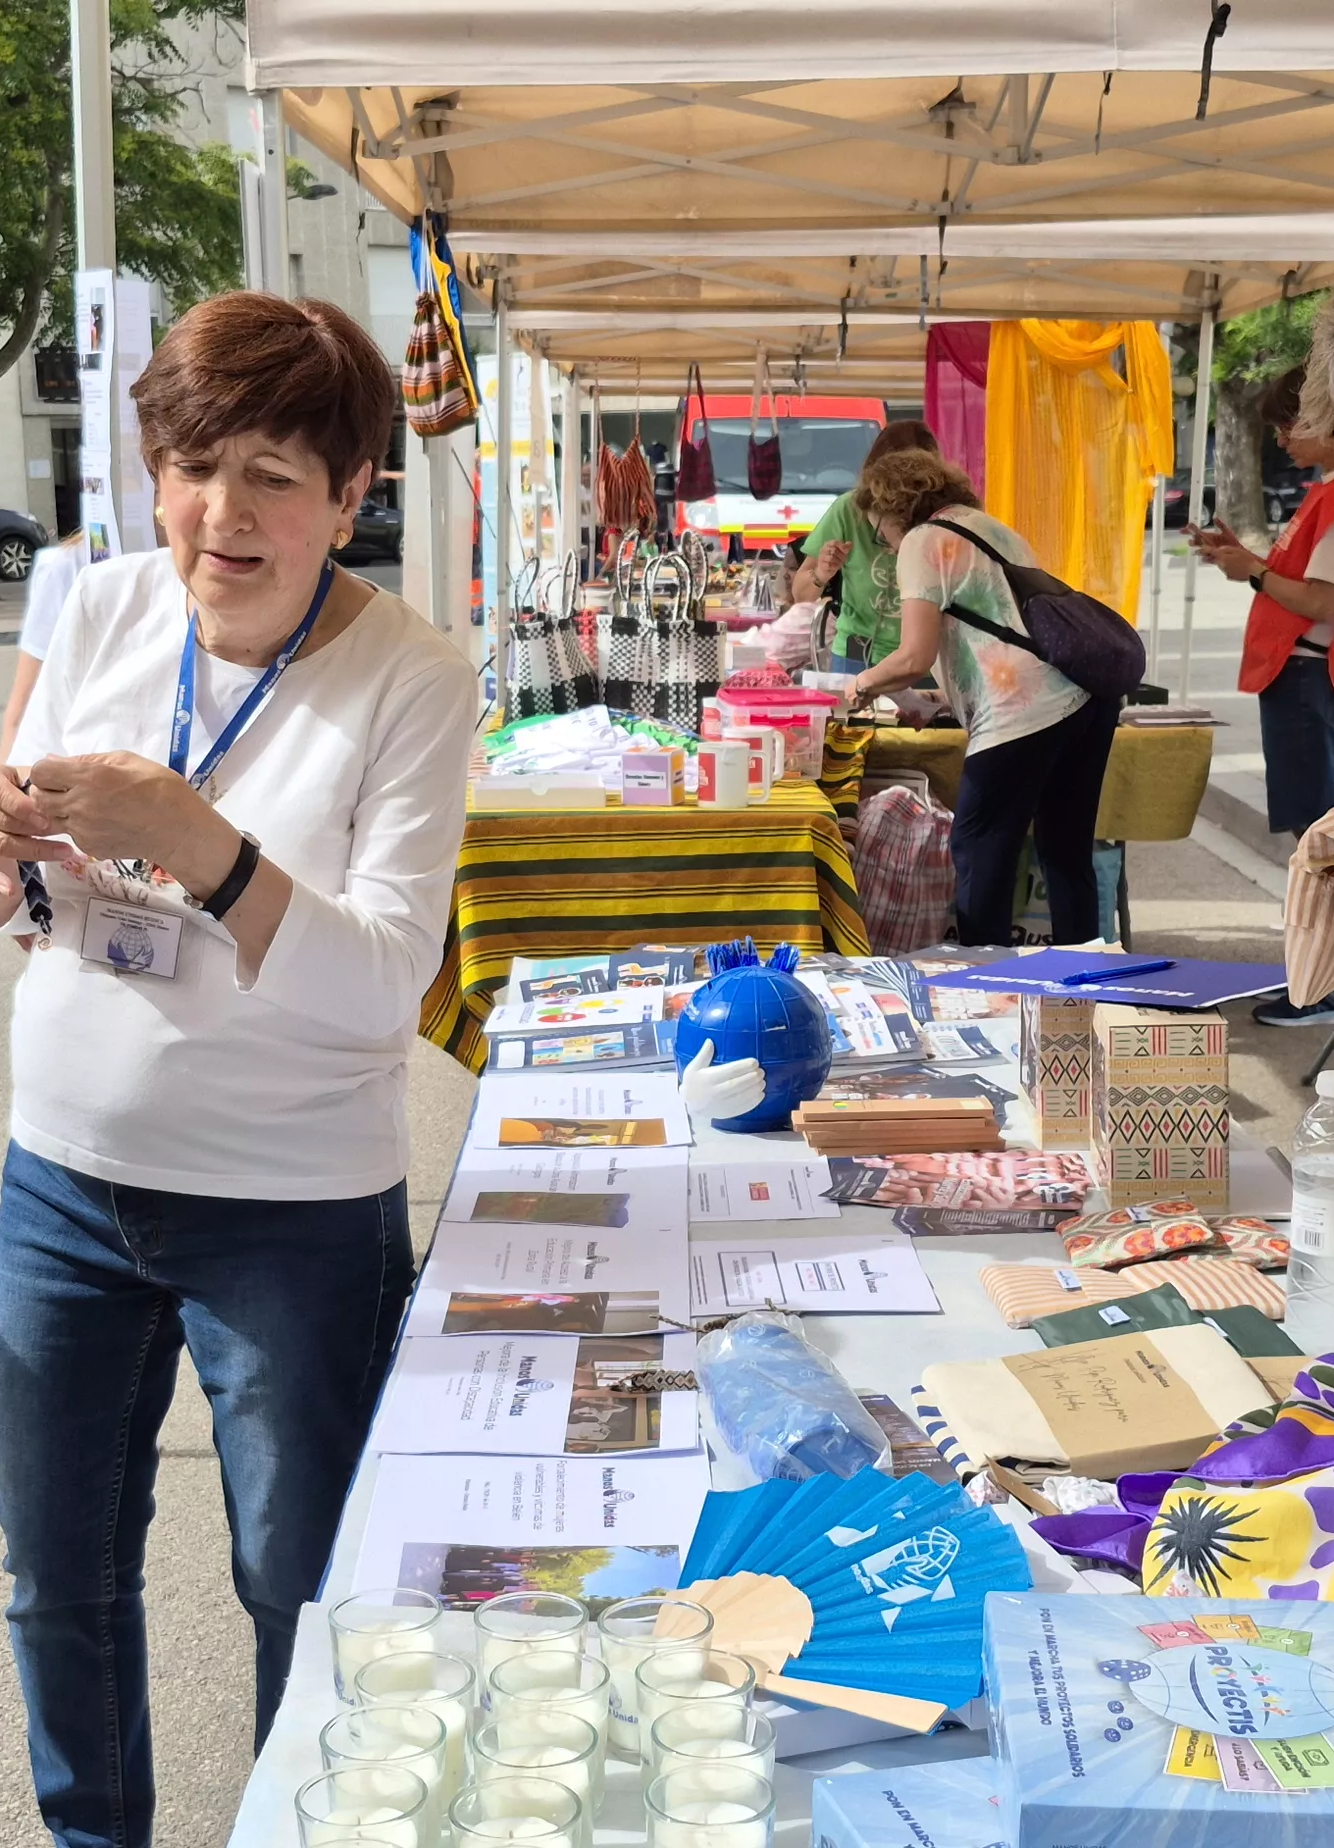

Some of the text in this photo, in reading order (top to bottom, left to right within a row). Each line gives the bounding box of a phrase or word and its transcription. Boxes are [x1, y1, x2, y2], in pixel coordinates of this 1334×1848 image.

[261, 632, 307, 694] Manos Unidas
[966, 975, 1195, 998] Manos Unidas
[499, 1341, 516, 1359] Mejora
[461, 1350, 490, 1420] Personas con Discapacidad
[492, 1373, 511, 1397] Inclusión
[509, 1356, 538, 1416] Manos Unidas
[485, 1398, 503, 1422] Educativa
[483, 1422, 497, 1431] de
[513, 1471, 524, 1495] violencia
[555, 1460, 568, 1502] Fortalecimiento
[602, 1467, 617, 1528] Manos Unidas
[533, 1522, 544, 1530] de
[553, 1511, 567, 1532] mujeres
[1039, 1608, 1053, 1622] PON
[1045, 1634, 1061, 1664] MARCHA
[1052, 1666, 1064, 1679] TUS
[1029, 1657, 1044, 1685] MEJORA
[1037, 1697, 1052, 1725] MUNDO
[1055, 1682, 1075, 1727] PROYECTOS
[1204, 1646, 1259, 1736] PROYECTIS
[1063, 1729, 1085, 1777] SOLIDARIOS
[882, 1790, 901, 1809] PON
[897, 1808, 915, 1822] EN
